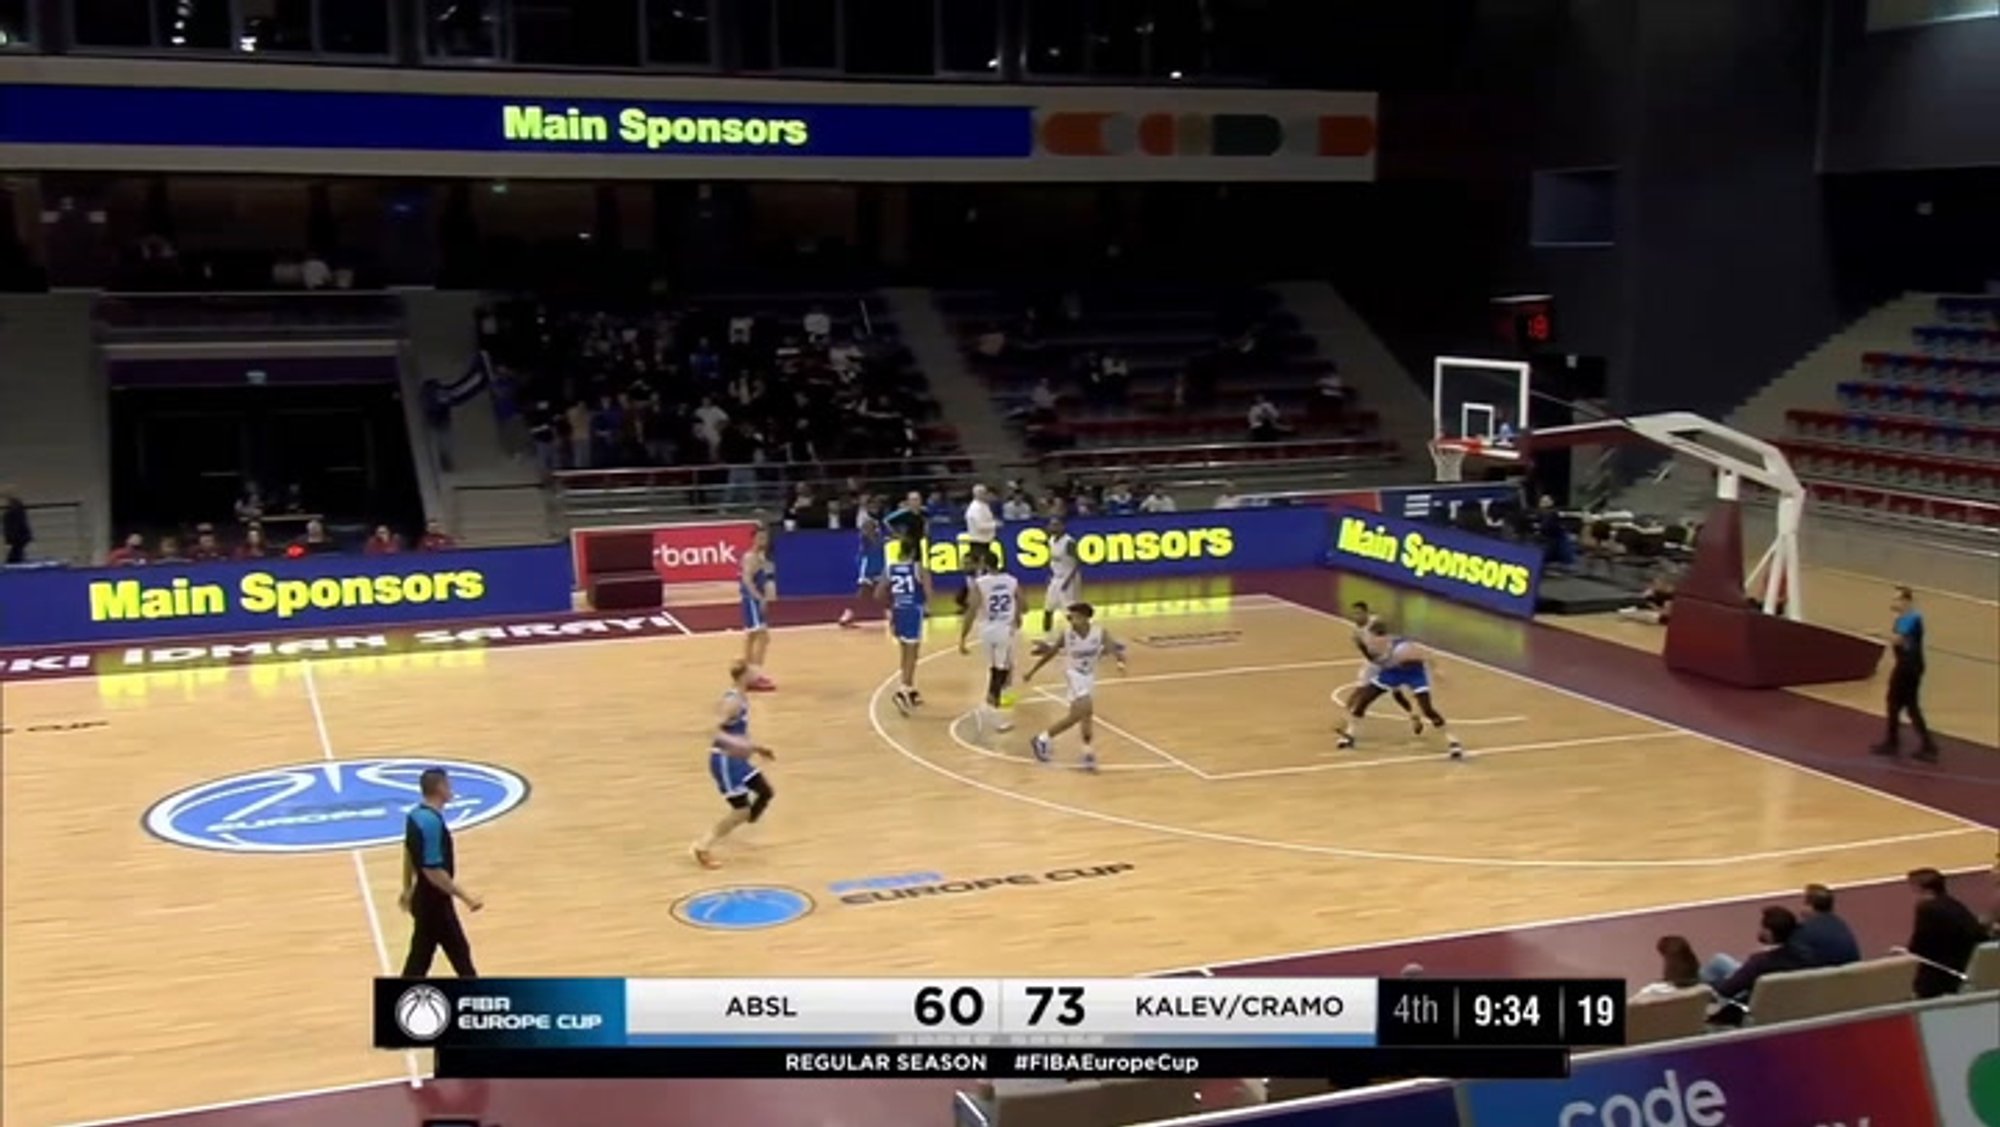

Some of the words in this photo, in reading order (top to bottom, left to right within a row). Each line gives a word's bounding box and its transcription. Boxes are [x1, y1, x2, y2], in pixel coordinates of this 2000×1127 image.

[503, 106, 607, 140] Main
[619, 108, 808, 148] Sponsors
[1017, 527, 1233, 568] Sonsors
[1338, 517, 1398, 562] Main
[1401, 532, 1529, 595] Sponsors
[90, 580, 224, 620] Main
[241, 571, 483, 617] Sponsors
[892, 575, 915, 593] 21
[989, 595, 1011, 612] 22
[0, 655, 90, 672] KI
[415, 616, 673, 643] SARAYI
[841, 874, 1038, 905] EUROPE
[1045, 861, 1134, 882] CUP
[1558, 1069, 1727, 1127] code
